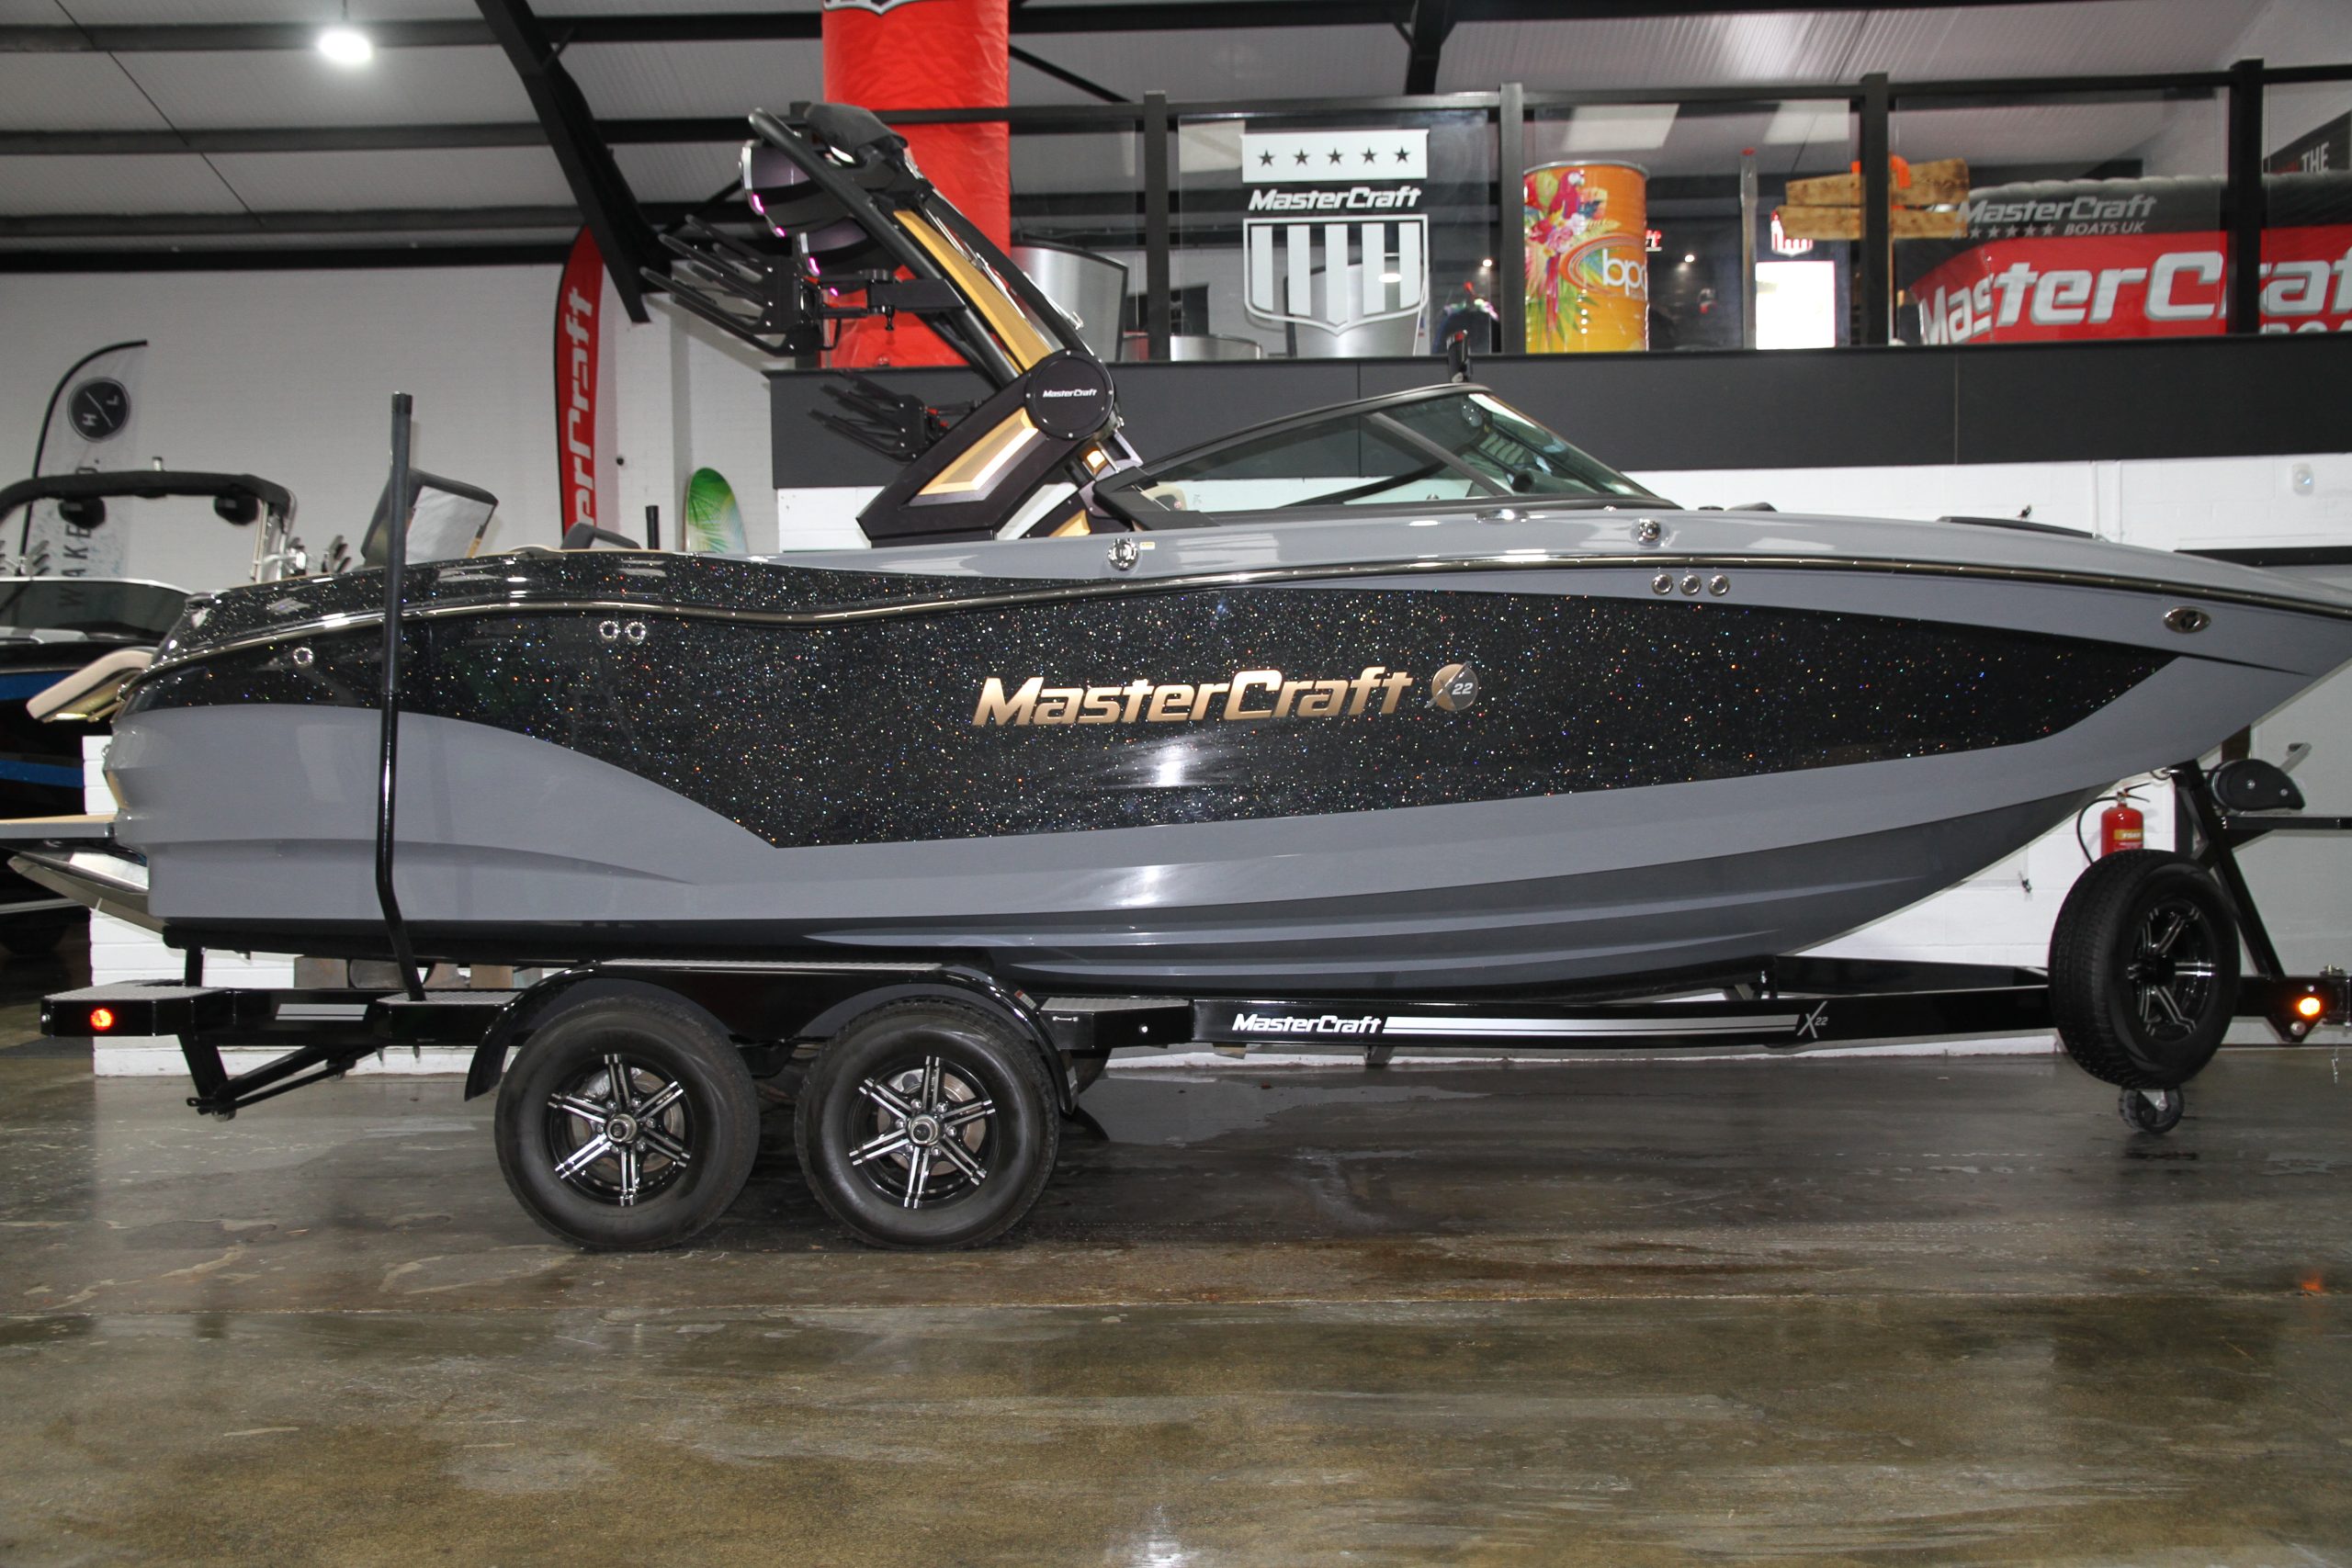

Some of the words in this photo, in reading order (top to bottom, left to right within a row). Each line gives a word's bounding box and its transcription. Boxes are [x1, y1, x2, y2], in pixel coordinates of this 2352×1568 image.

[2301, 141, 2329, 172] THE
[1248, 186, 1421, 210] MasterCraft
[1954, 194, 2157, 223] MasterCraft
[2064, 223, 2121, 236] BOATS
[2123, 220, 2146, 234] UK
[1602, 248, 1647, 296] bp
[565, 287, 594, 525] erCraft
[1043, 389, 1097, 398] MasterCraft
[971, 667, 1413, 726] MasterCraft
[1232, 1013, 1381, 1033] MasterCraft
